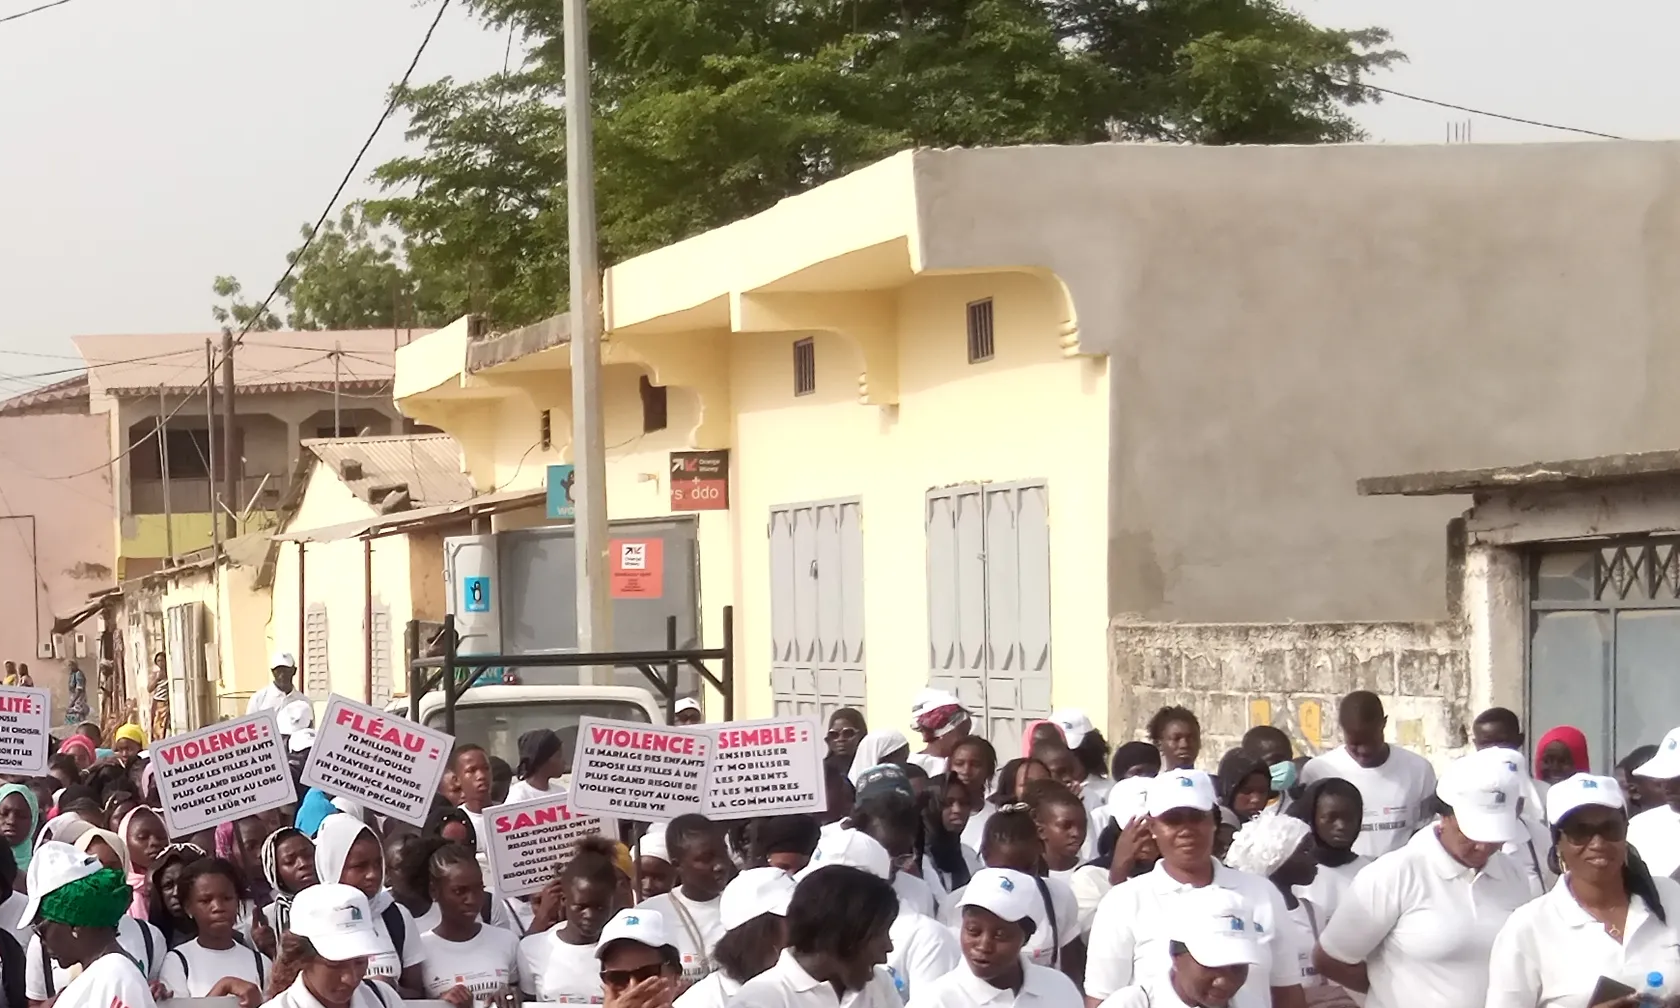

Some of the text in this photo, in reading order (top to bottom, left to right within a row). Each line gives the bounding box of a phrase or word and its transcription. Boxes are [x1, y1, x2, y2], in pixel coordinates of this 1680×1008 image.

[160, 723, 258, 765] VIOLENCE
[336, 708, 425, 753] FLÉAU
[591, 727, 695, 756] VIOLENCE
[175, 758, 216, 775] MARIAGE
[219, 751, 234, 761] DES
[236, 740, 274, 756] ENFANTS
[360, 737, 403, 758] MILLIONS
[404, 754, 416, 763] DE
[727, 759, 791, 771] MOBILISER
[171, 753, 272, 788] EXPOSE LES FILLES UN
[173, 764, 276, 800] PLUS GRAND RISQUE DE
[316, 760, 425, 804] FIN ABRUPTE
[332, 776, 366, 795] AVENIR
[336, 753, 374, 774] TRAVERS
[387, 773, 421, 791] MONDE
[737, 771, 788, 782] PARENTS
[171, 775, 283, 813] VIOLENCE TOUT AU LONG
[205, 795, 257, 815] DE LEUR VIE
[722, 782, 799, 795] LES MEMBRES
